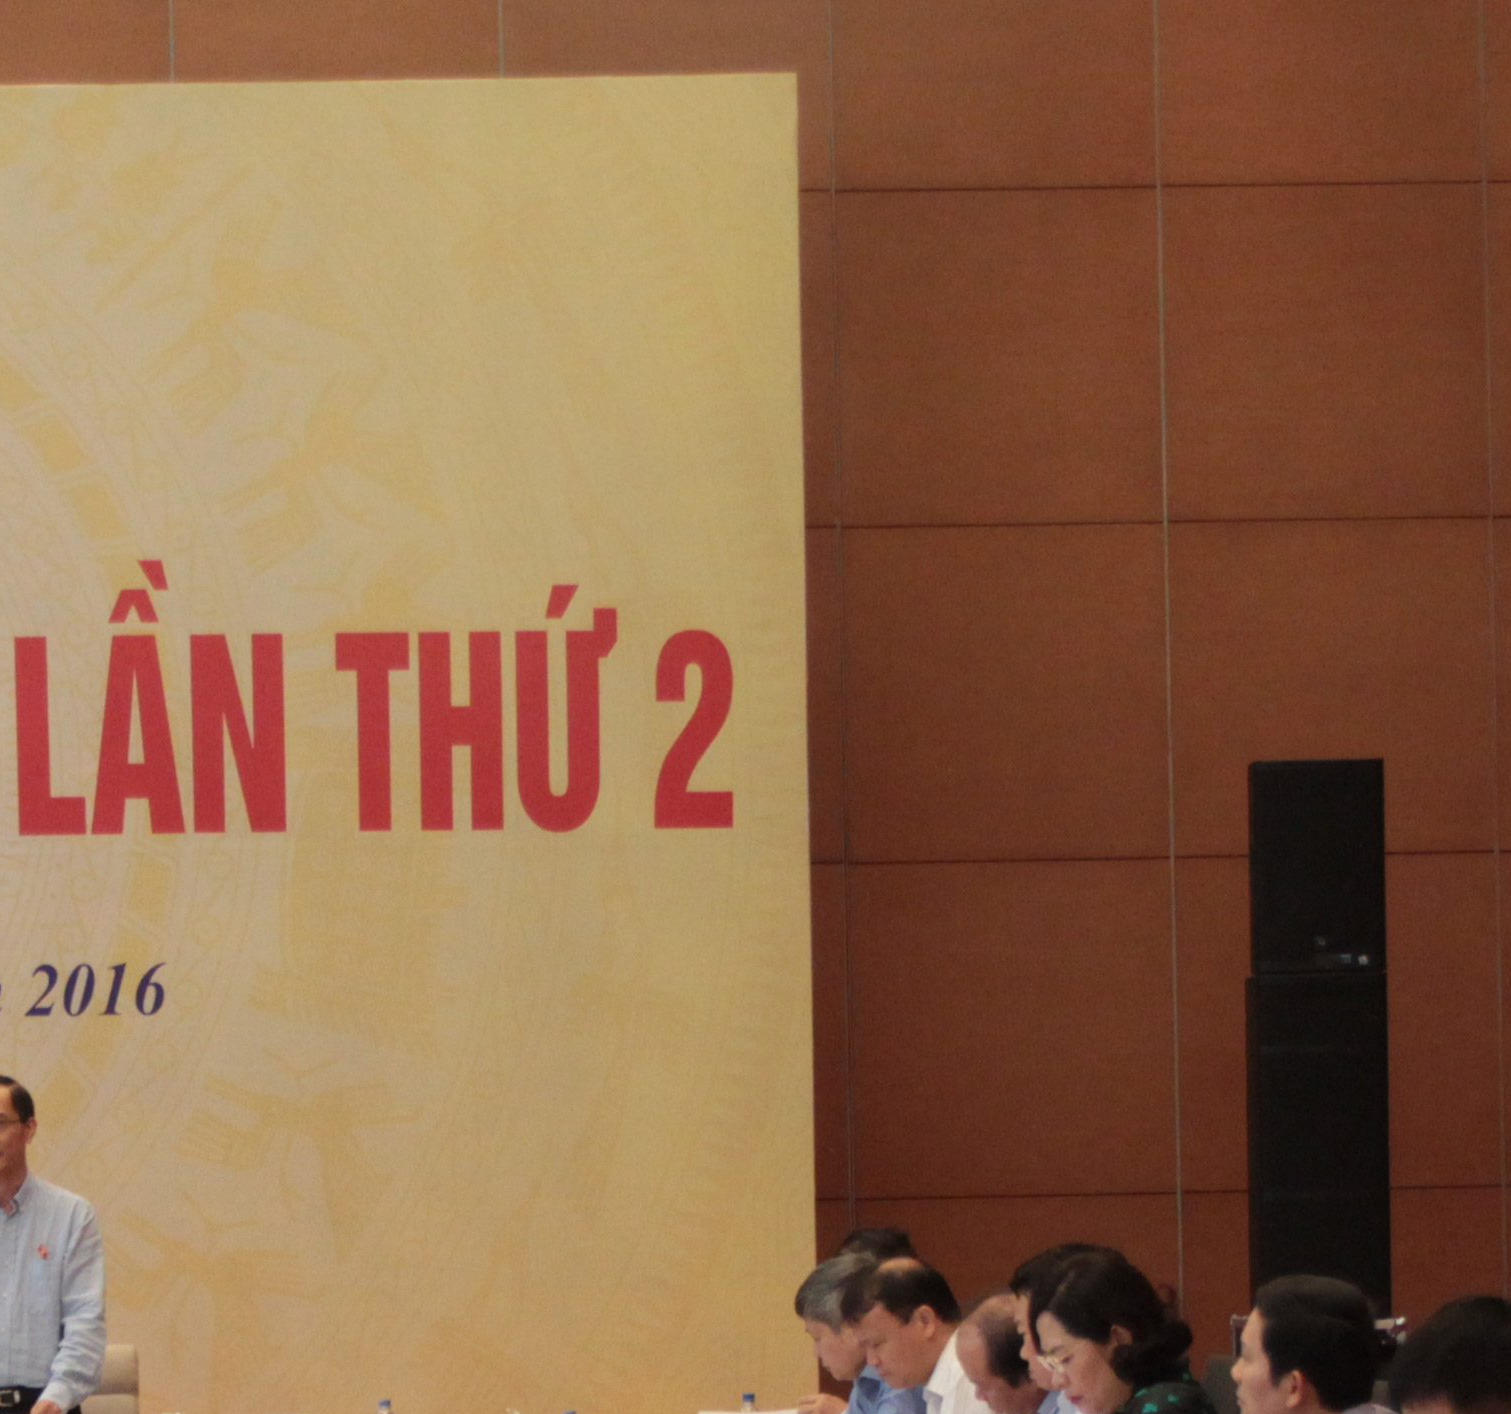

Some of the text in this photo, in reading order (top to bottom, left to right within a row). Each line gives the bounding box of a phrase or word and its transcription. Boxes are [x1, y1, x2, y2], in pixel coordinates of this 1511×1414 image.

[13, 559, 288, 836] LẦN
[334, 584, 618, 833] THỨ
[652, 628, 734, 830] 2
[24, 961, 167, 1018] 2016
